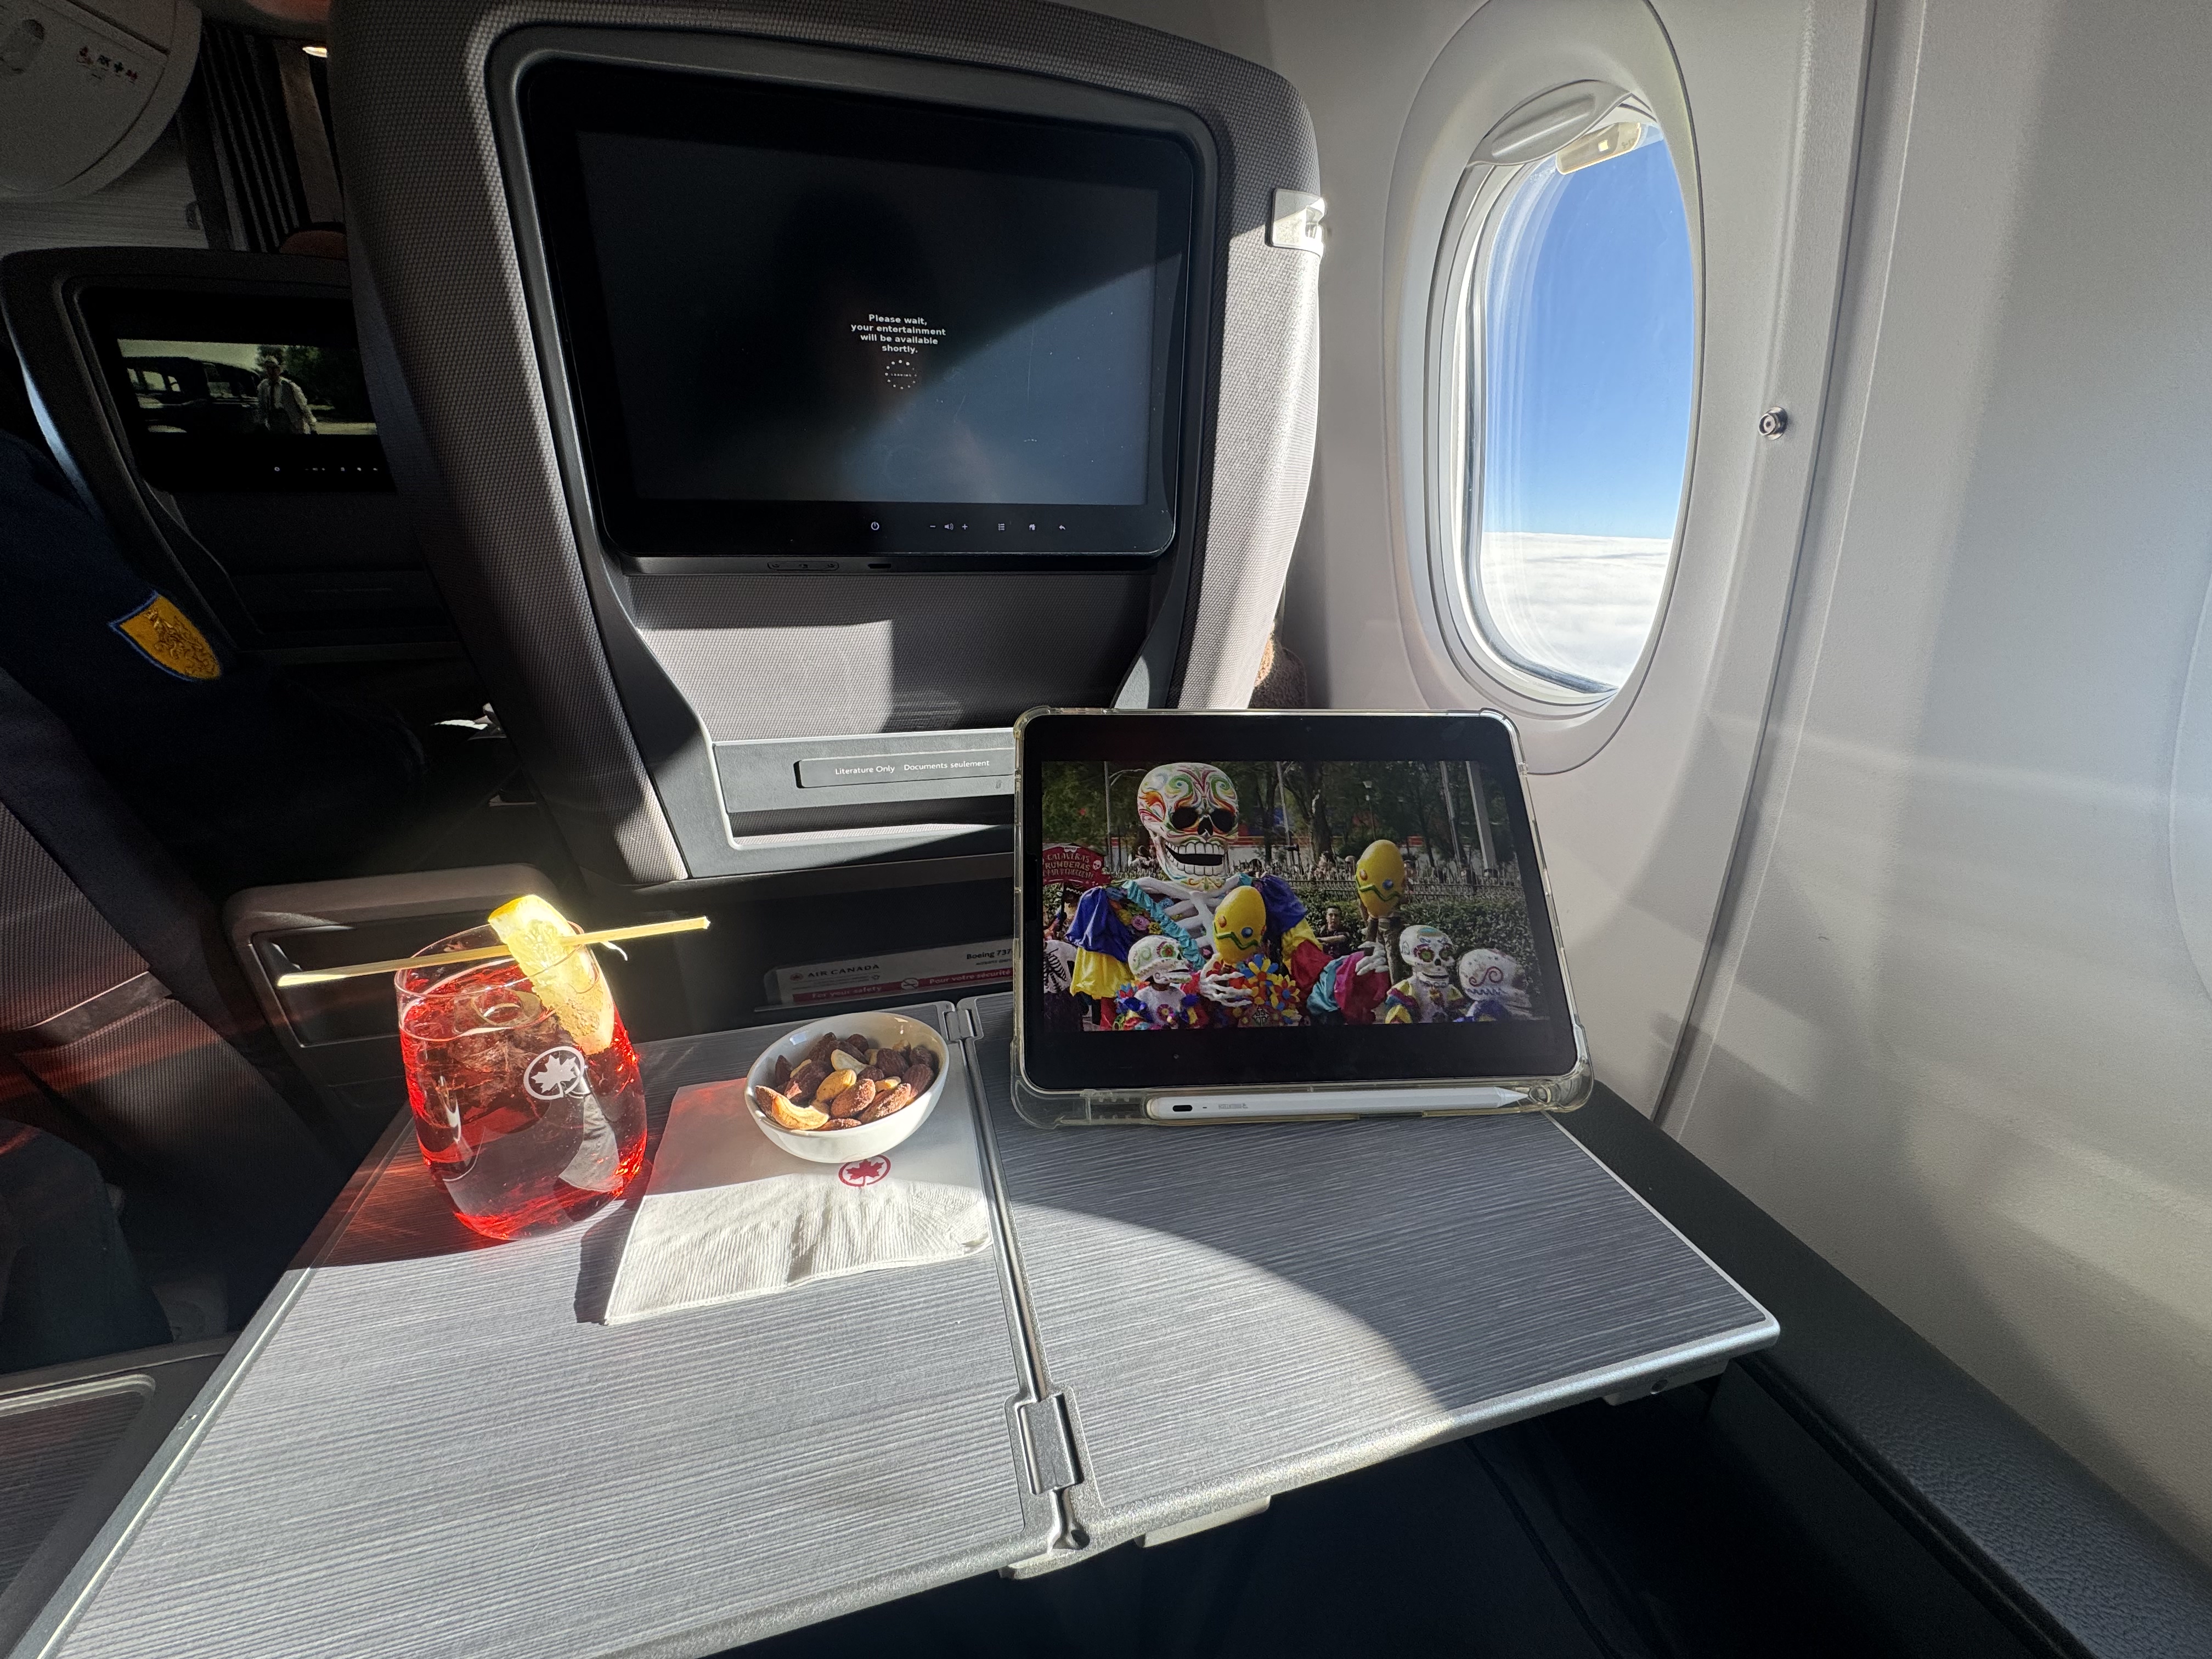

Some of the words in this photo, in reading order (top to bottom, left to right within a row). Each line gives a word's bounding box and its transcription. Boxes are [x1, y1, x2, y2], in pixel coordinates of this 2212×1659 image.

[869, 314, 901, 323] Please
[904, 317, 927, 325] wait,
[877, 325, 946, 336] entertainment
[895, 336, 938, 345] available
[882, 345, 918, 354] shortly.
[835, 766, 874, 775] Literature
[876, 765, 895, 774] Only
[904, 762, 948, 771] Documents
[950, 760, 990, 769] seulement
[831, 964, 879, 974] CANADA
